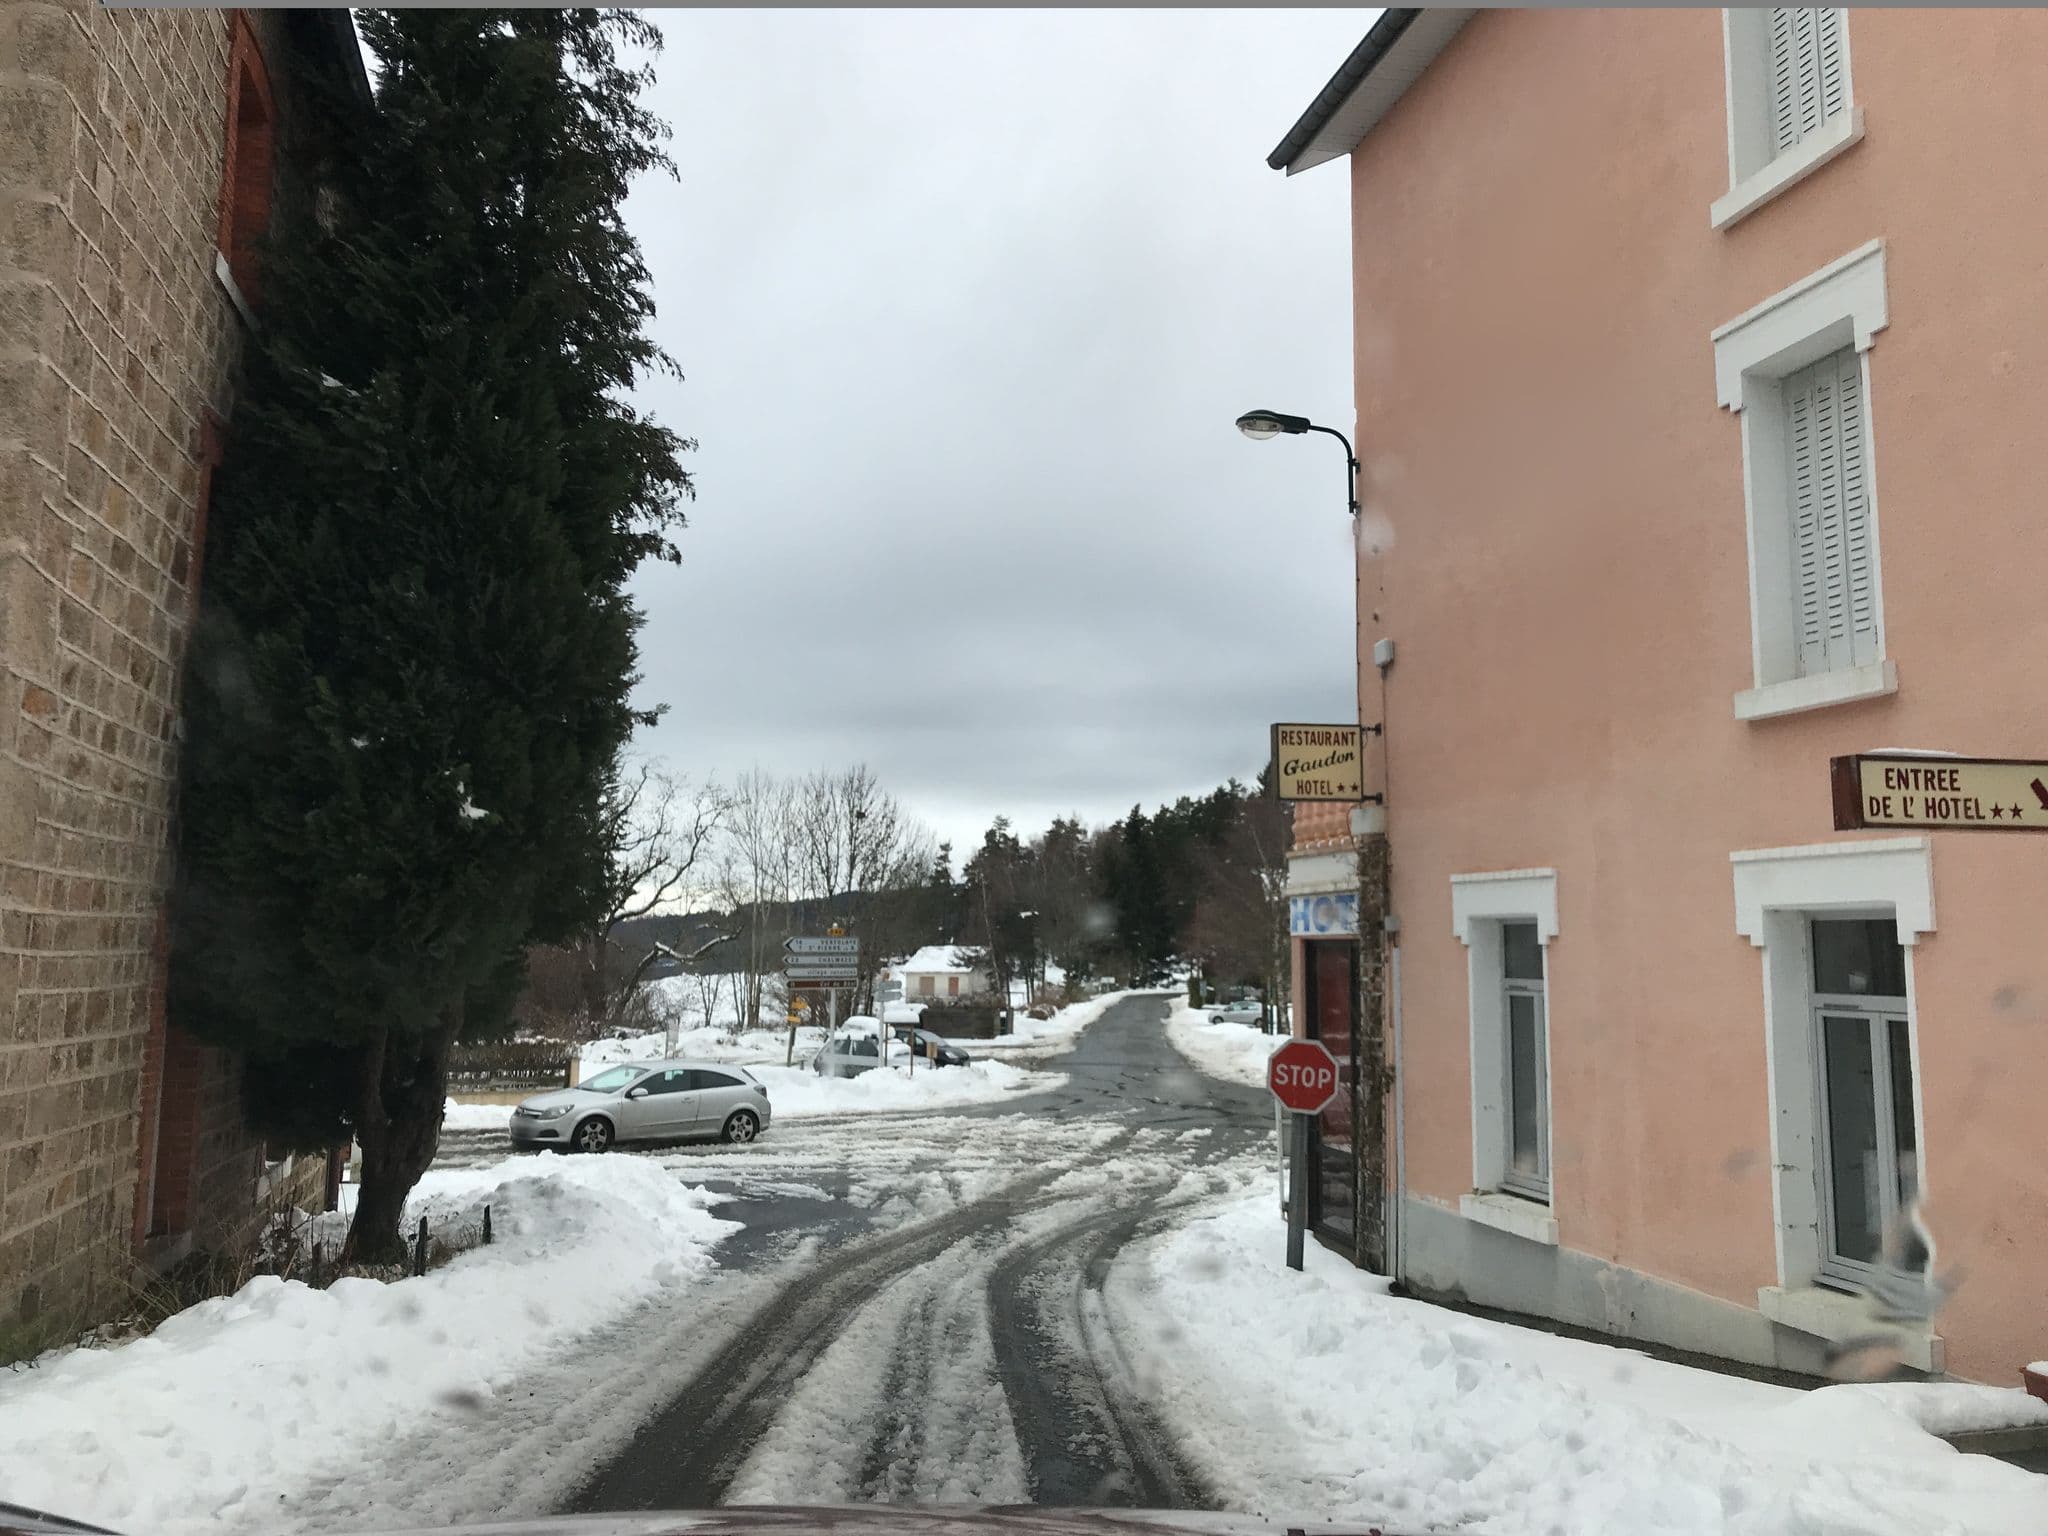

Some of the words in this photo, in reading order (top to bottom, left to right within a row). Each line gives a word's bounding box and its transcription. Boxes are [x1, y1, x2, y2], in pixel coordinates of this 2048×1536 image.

[1281, 730, 1356, 746] RESTAURANT
[1284, 750, 1355, 776] Gaudon
[1296, 779, 1333, 795] HOTEL
[1884, 767, 1961, 791] ENTREE
[1869, 795, 1893, 818] DE
[1924, 797, 1985, 819] HOTEL
[1275, 1063, 1331, 1089] STOP
